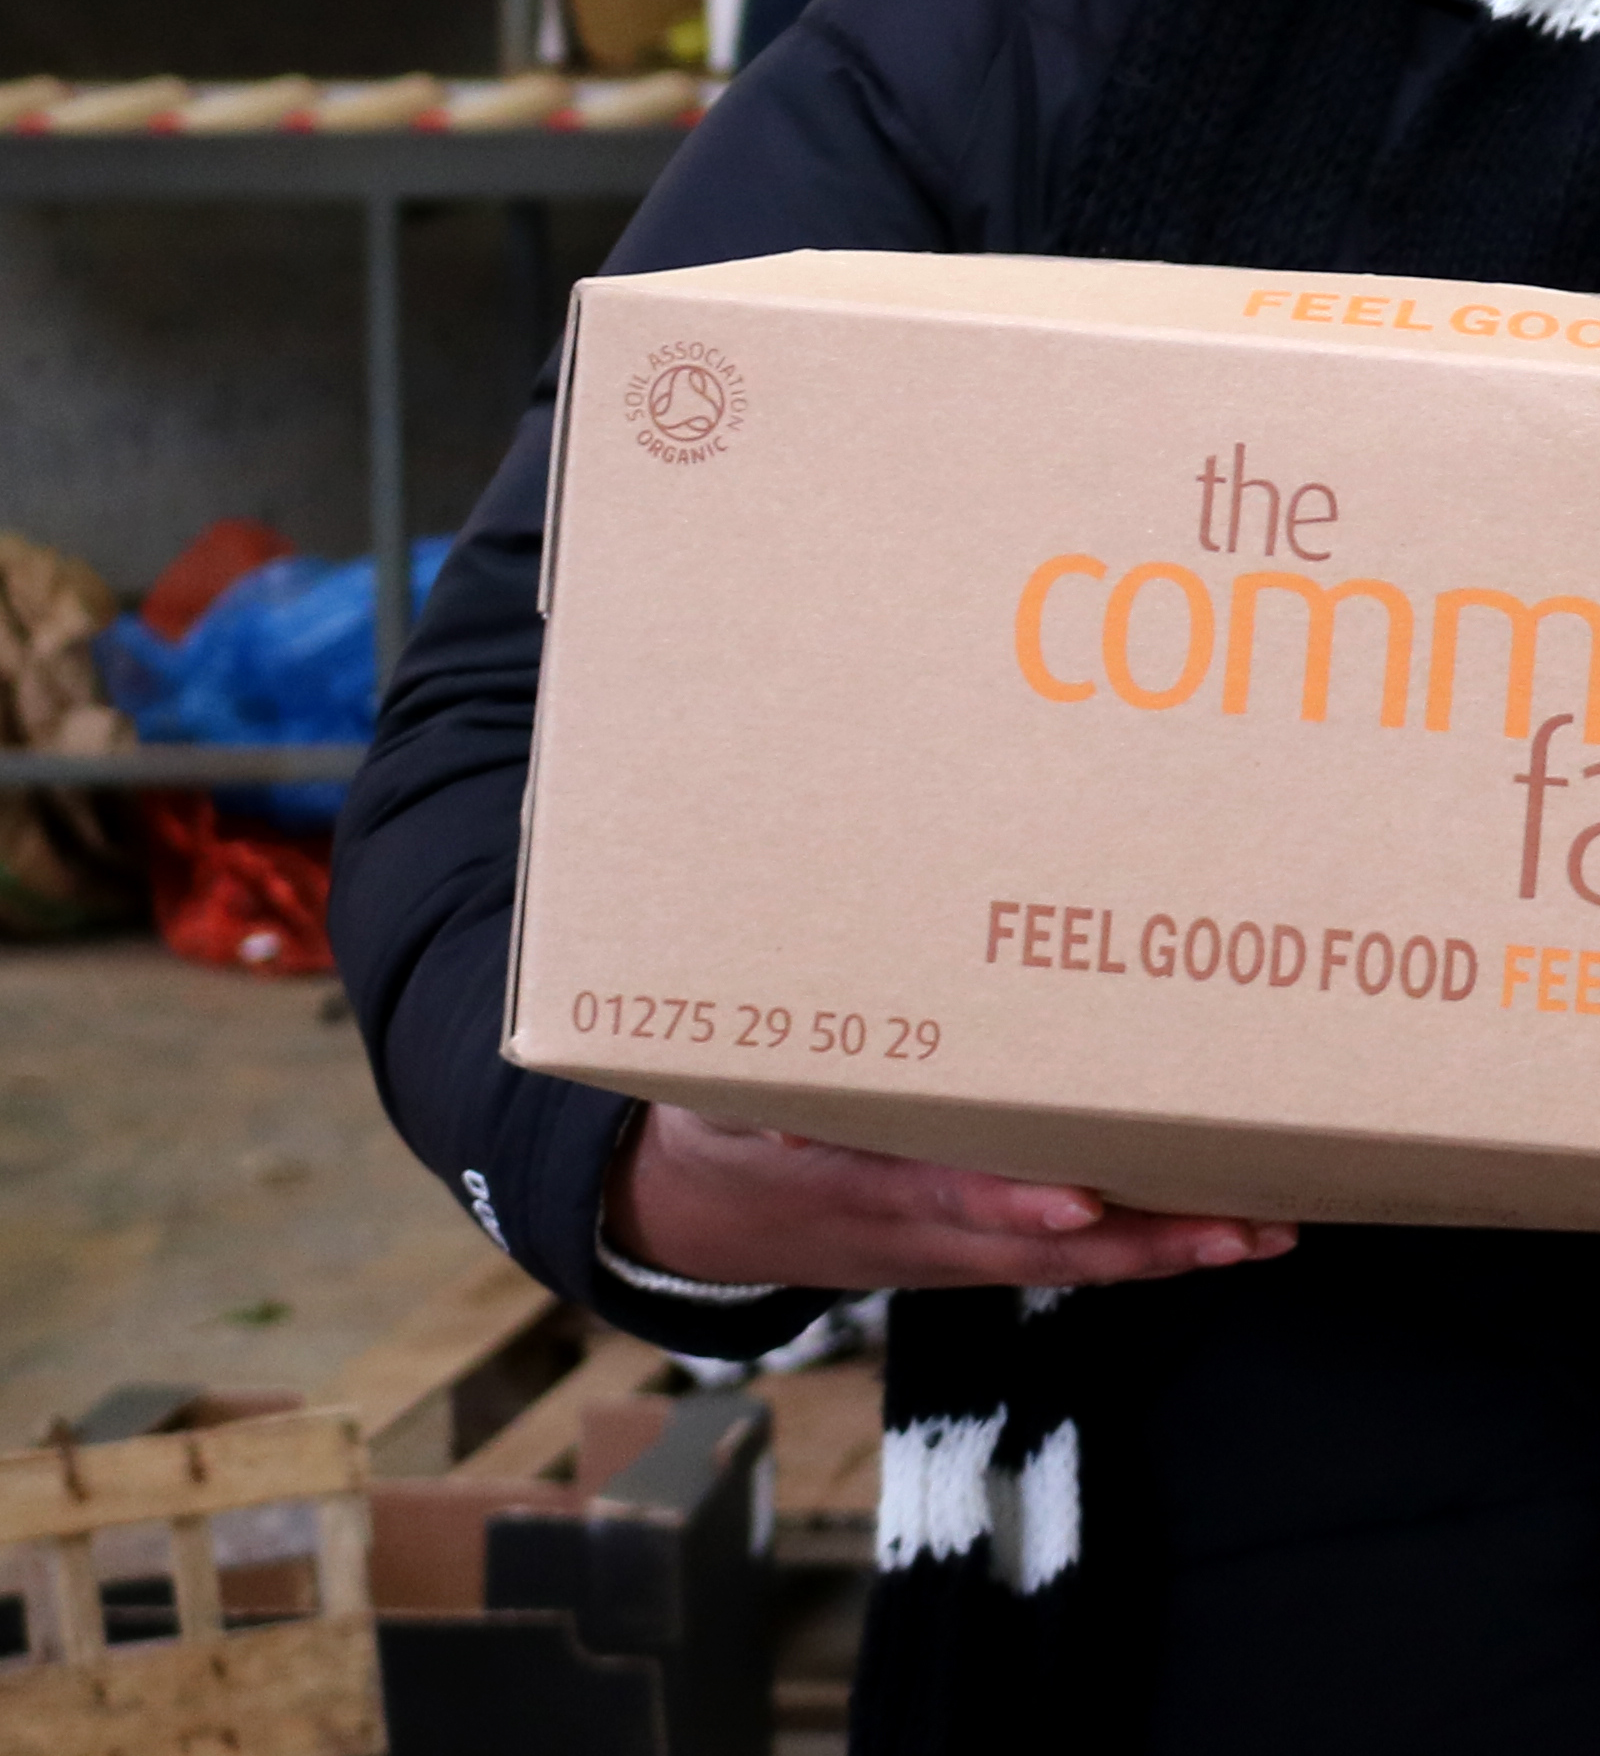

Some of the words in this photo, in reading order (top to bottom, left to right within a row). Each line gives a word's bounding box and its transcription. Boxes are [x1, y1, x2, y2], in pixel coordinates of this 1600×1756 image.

[1243, 289, 1433, 331] FEEL
[624, 374, 651, 422] SOIL
[647, 341, 748, 432] ASSOCIATION
[637, 429, 729, 465] ORGANIC
[1195, 443, 1339, 562] the
[985, 900, 1127, 975] FEEL
[1139, 914, 1307, 988] GOOD
[1319, 929, 1479, 1003] FOOD
[572, 989, 717, 1044] 01275
[734, 1004, 793, 1049] 29
[810, 1010, 867, 1057] 50
[883, 1017, 942, 1061] 29
